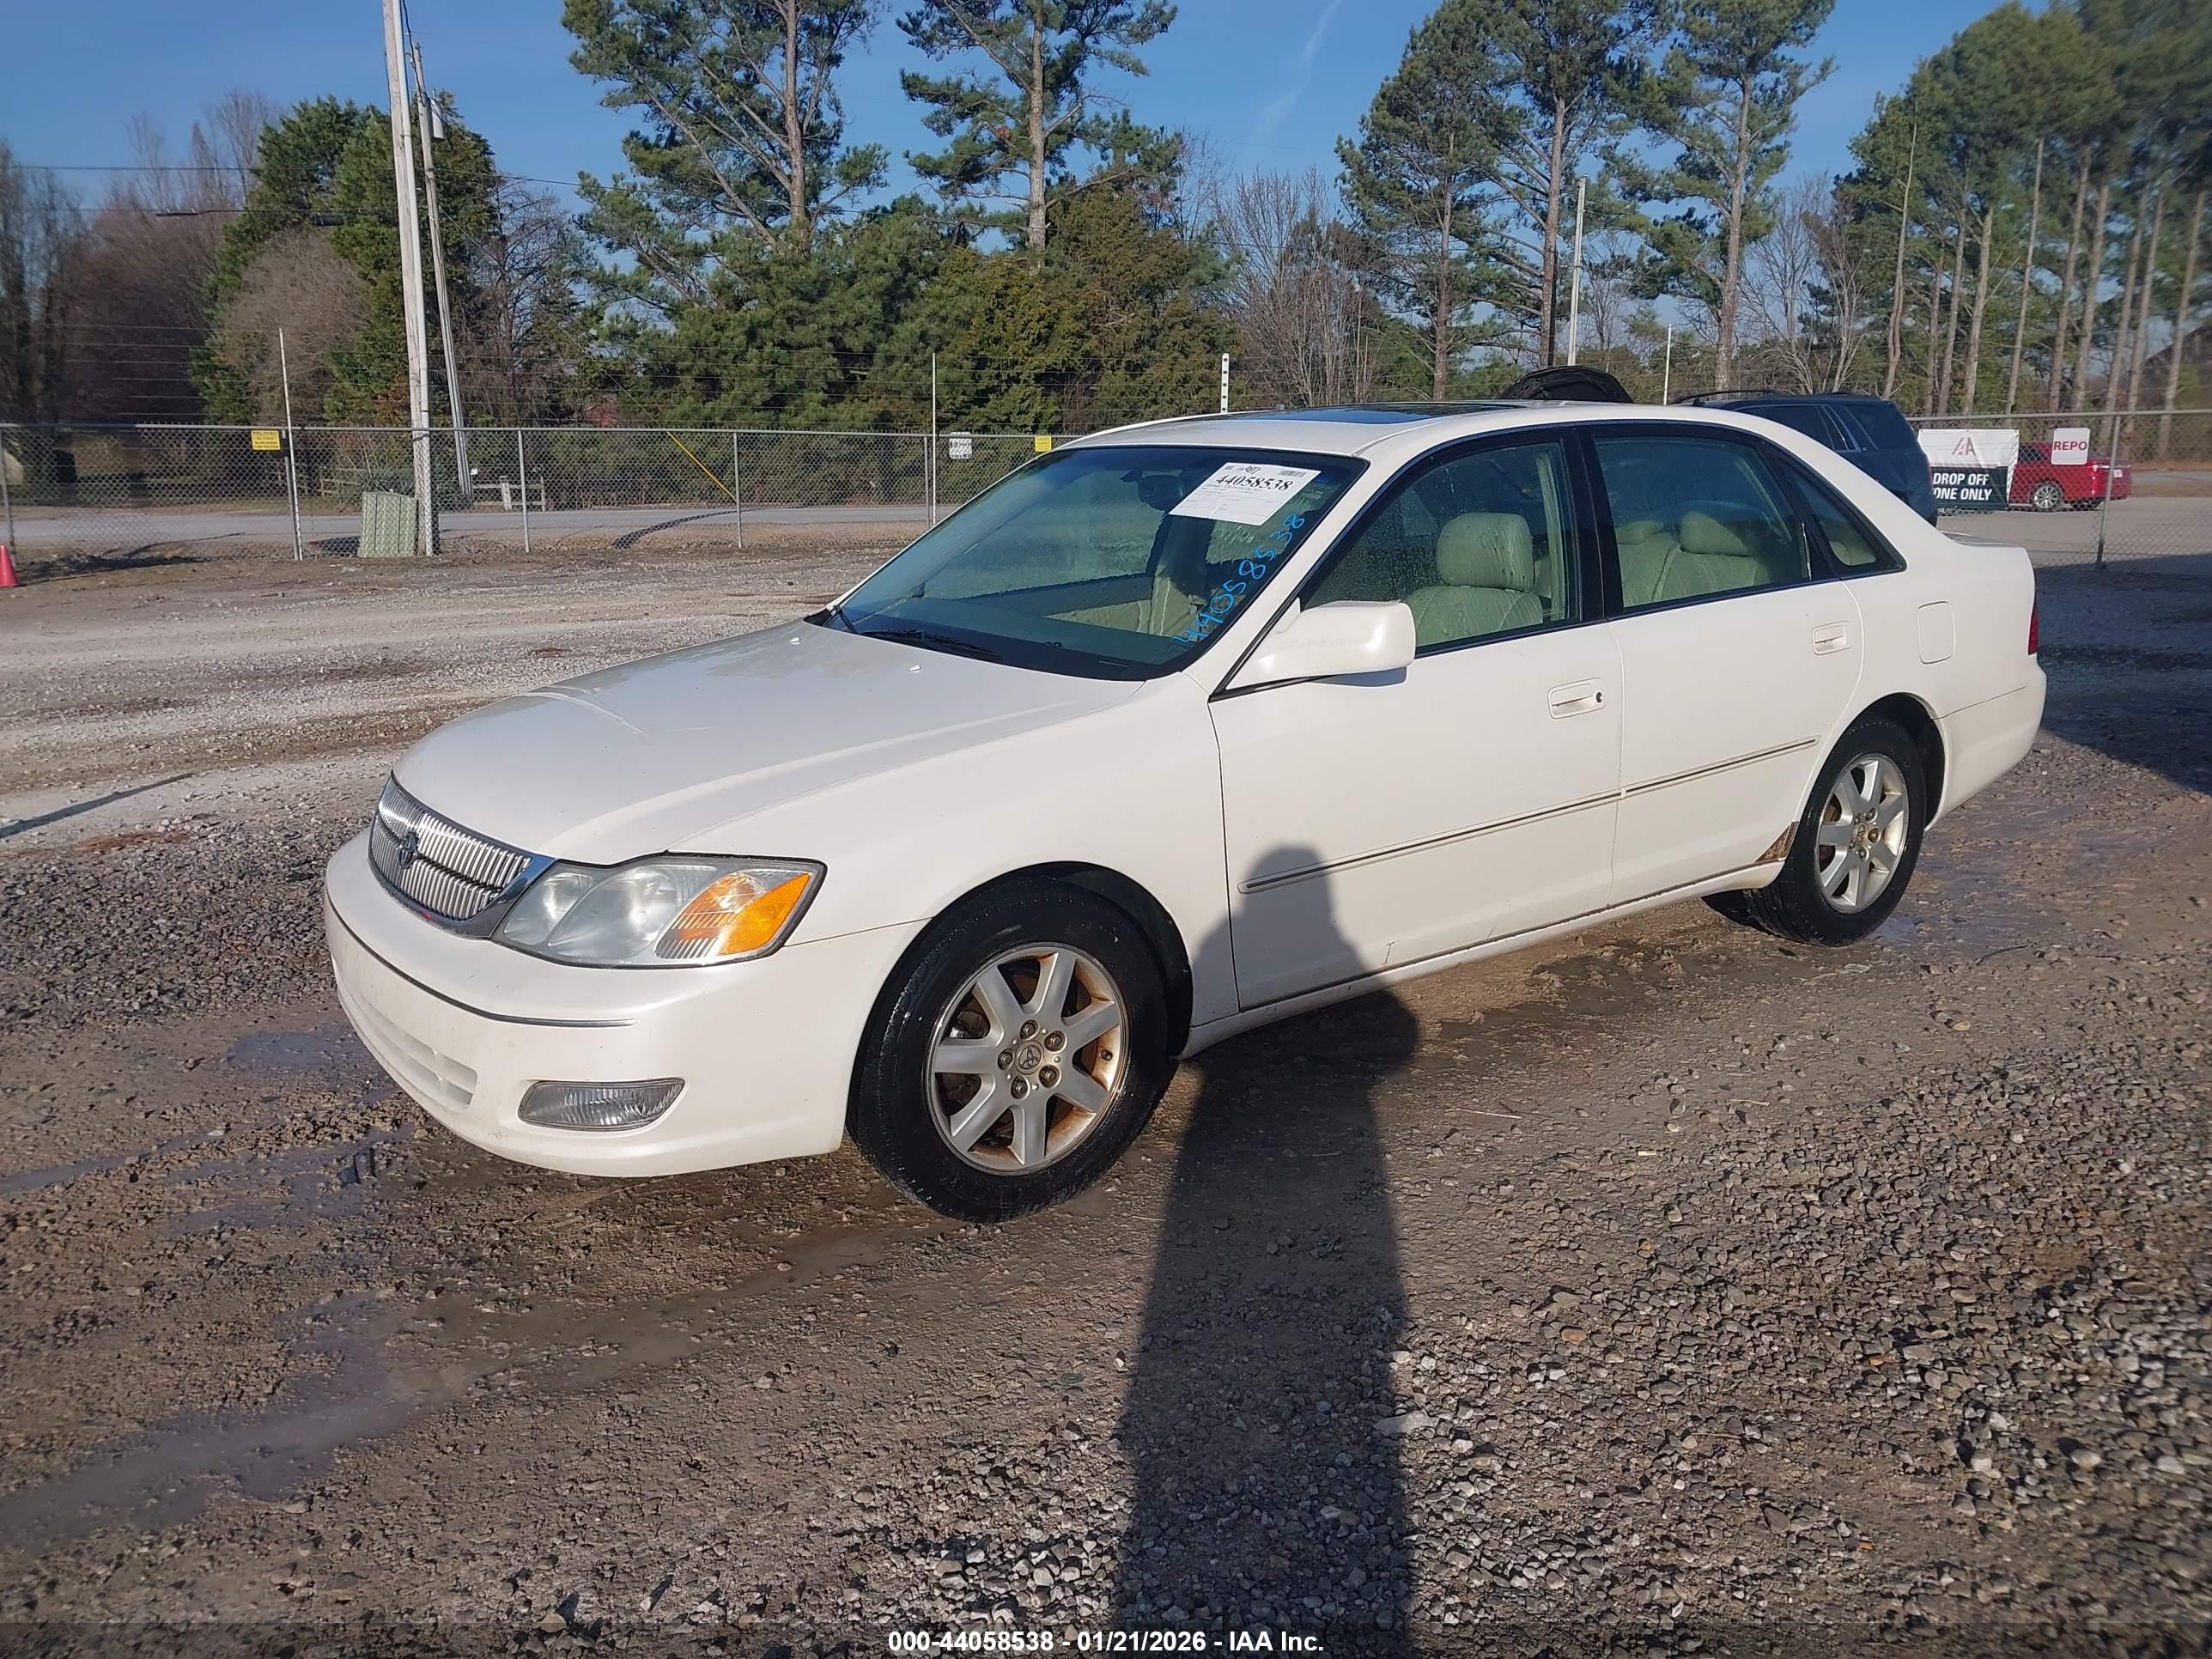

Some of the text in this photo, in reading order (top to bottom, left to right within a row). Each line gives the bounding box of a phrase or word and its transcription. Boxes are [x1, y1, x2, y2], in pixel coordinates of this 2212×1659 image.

[2053, 441, 2087, 451] REPO
[1216, 475, 1293, 491] 44058538
[1933, 472, 1990, 486] DROP OFF
[1960, 488, 1993, 501] ONLY
[1171, 514, 1305, 645] 44058538
